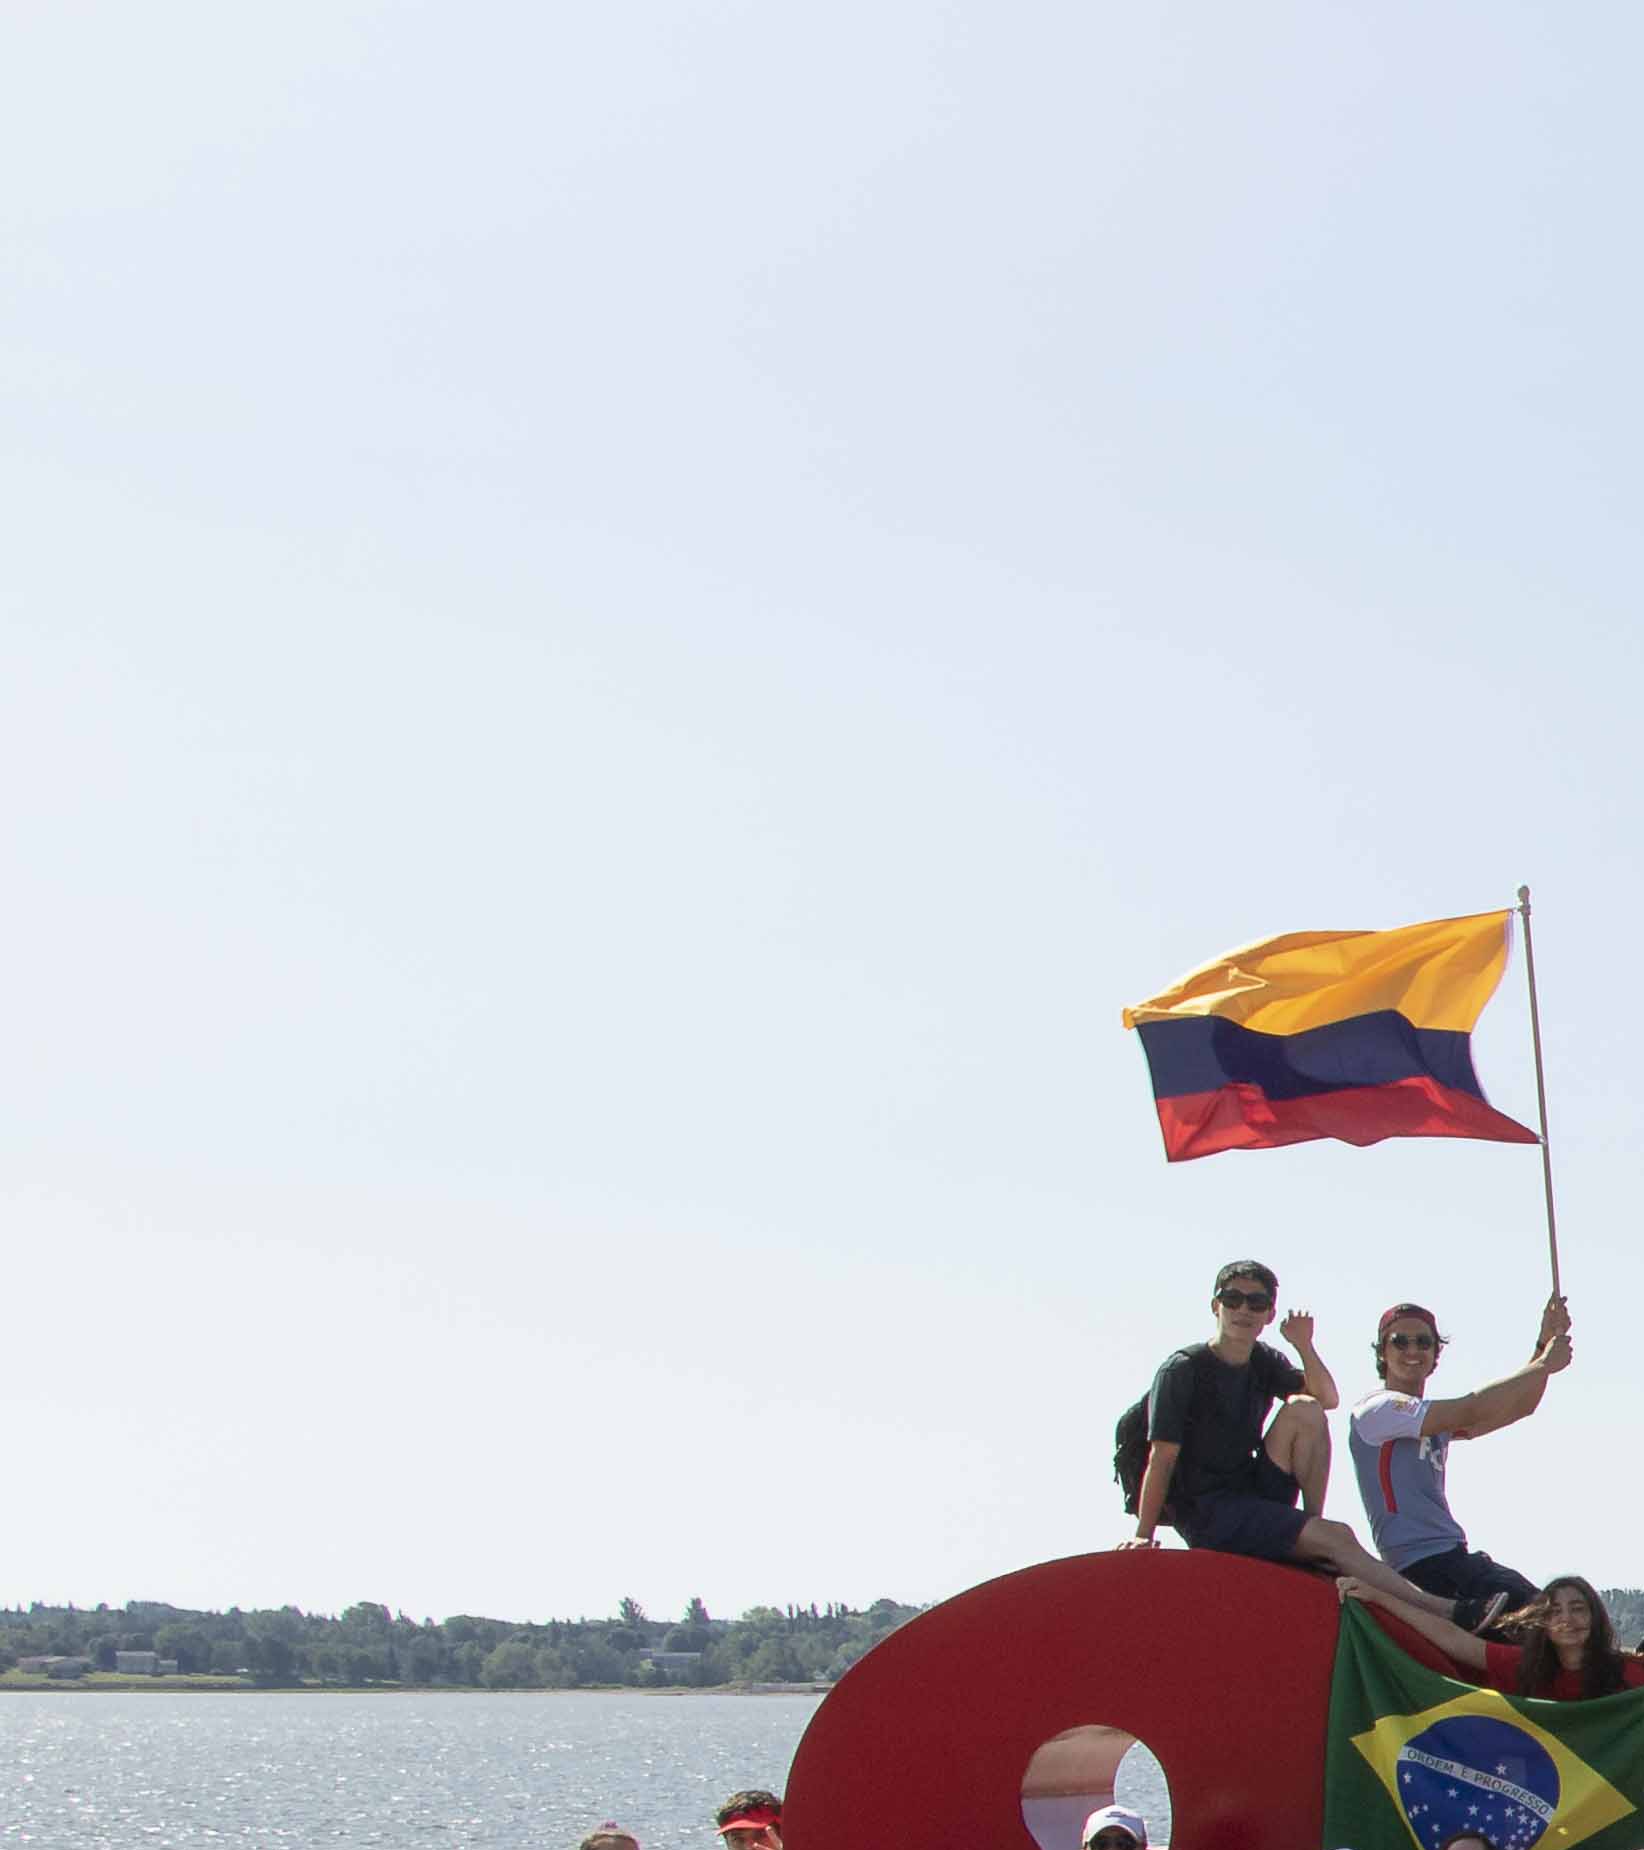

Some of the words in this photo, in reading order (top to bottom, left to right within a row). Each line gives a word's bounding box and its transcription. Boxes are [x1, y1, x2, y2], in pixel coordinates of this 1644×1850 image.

[1407, 1749, 1454, 1774] ORDEM
[1460, 1767, 1470, 1779] E
[1474, 1773, 1550, 1816] PROGRESSO
